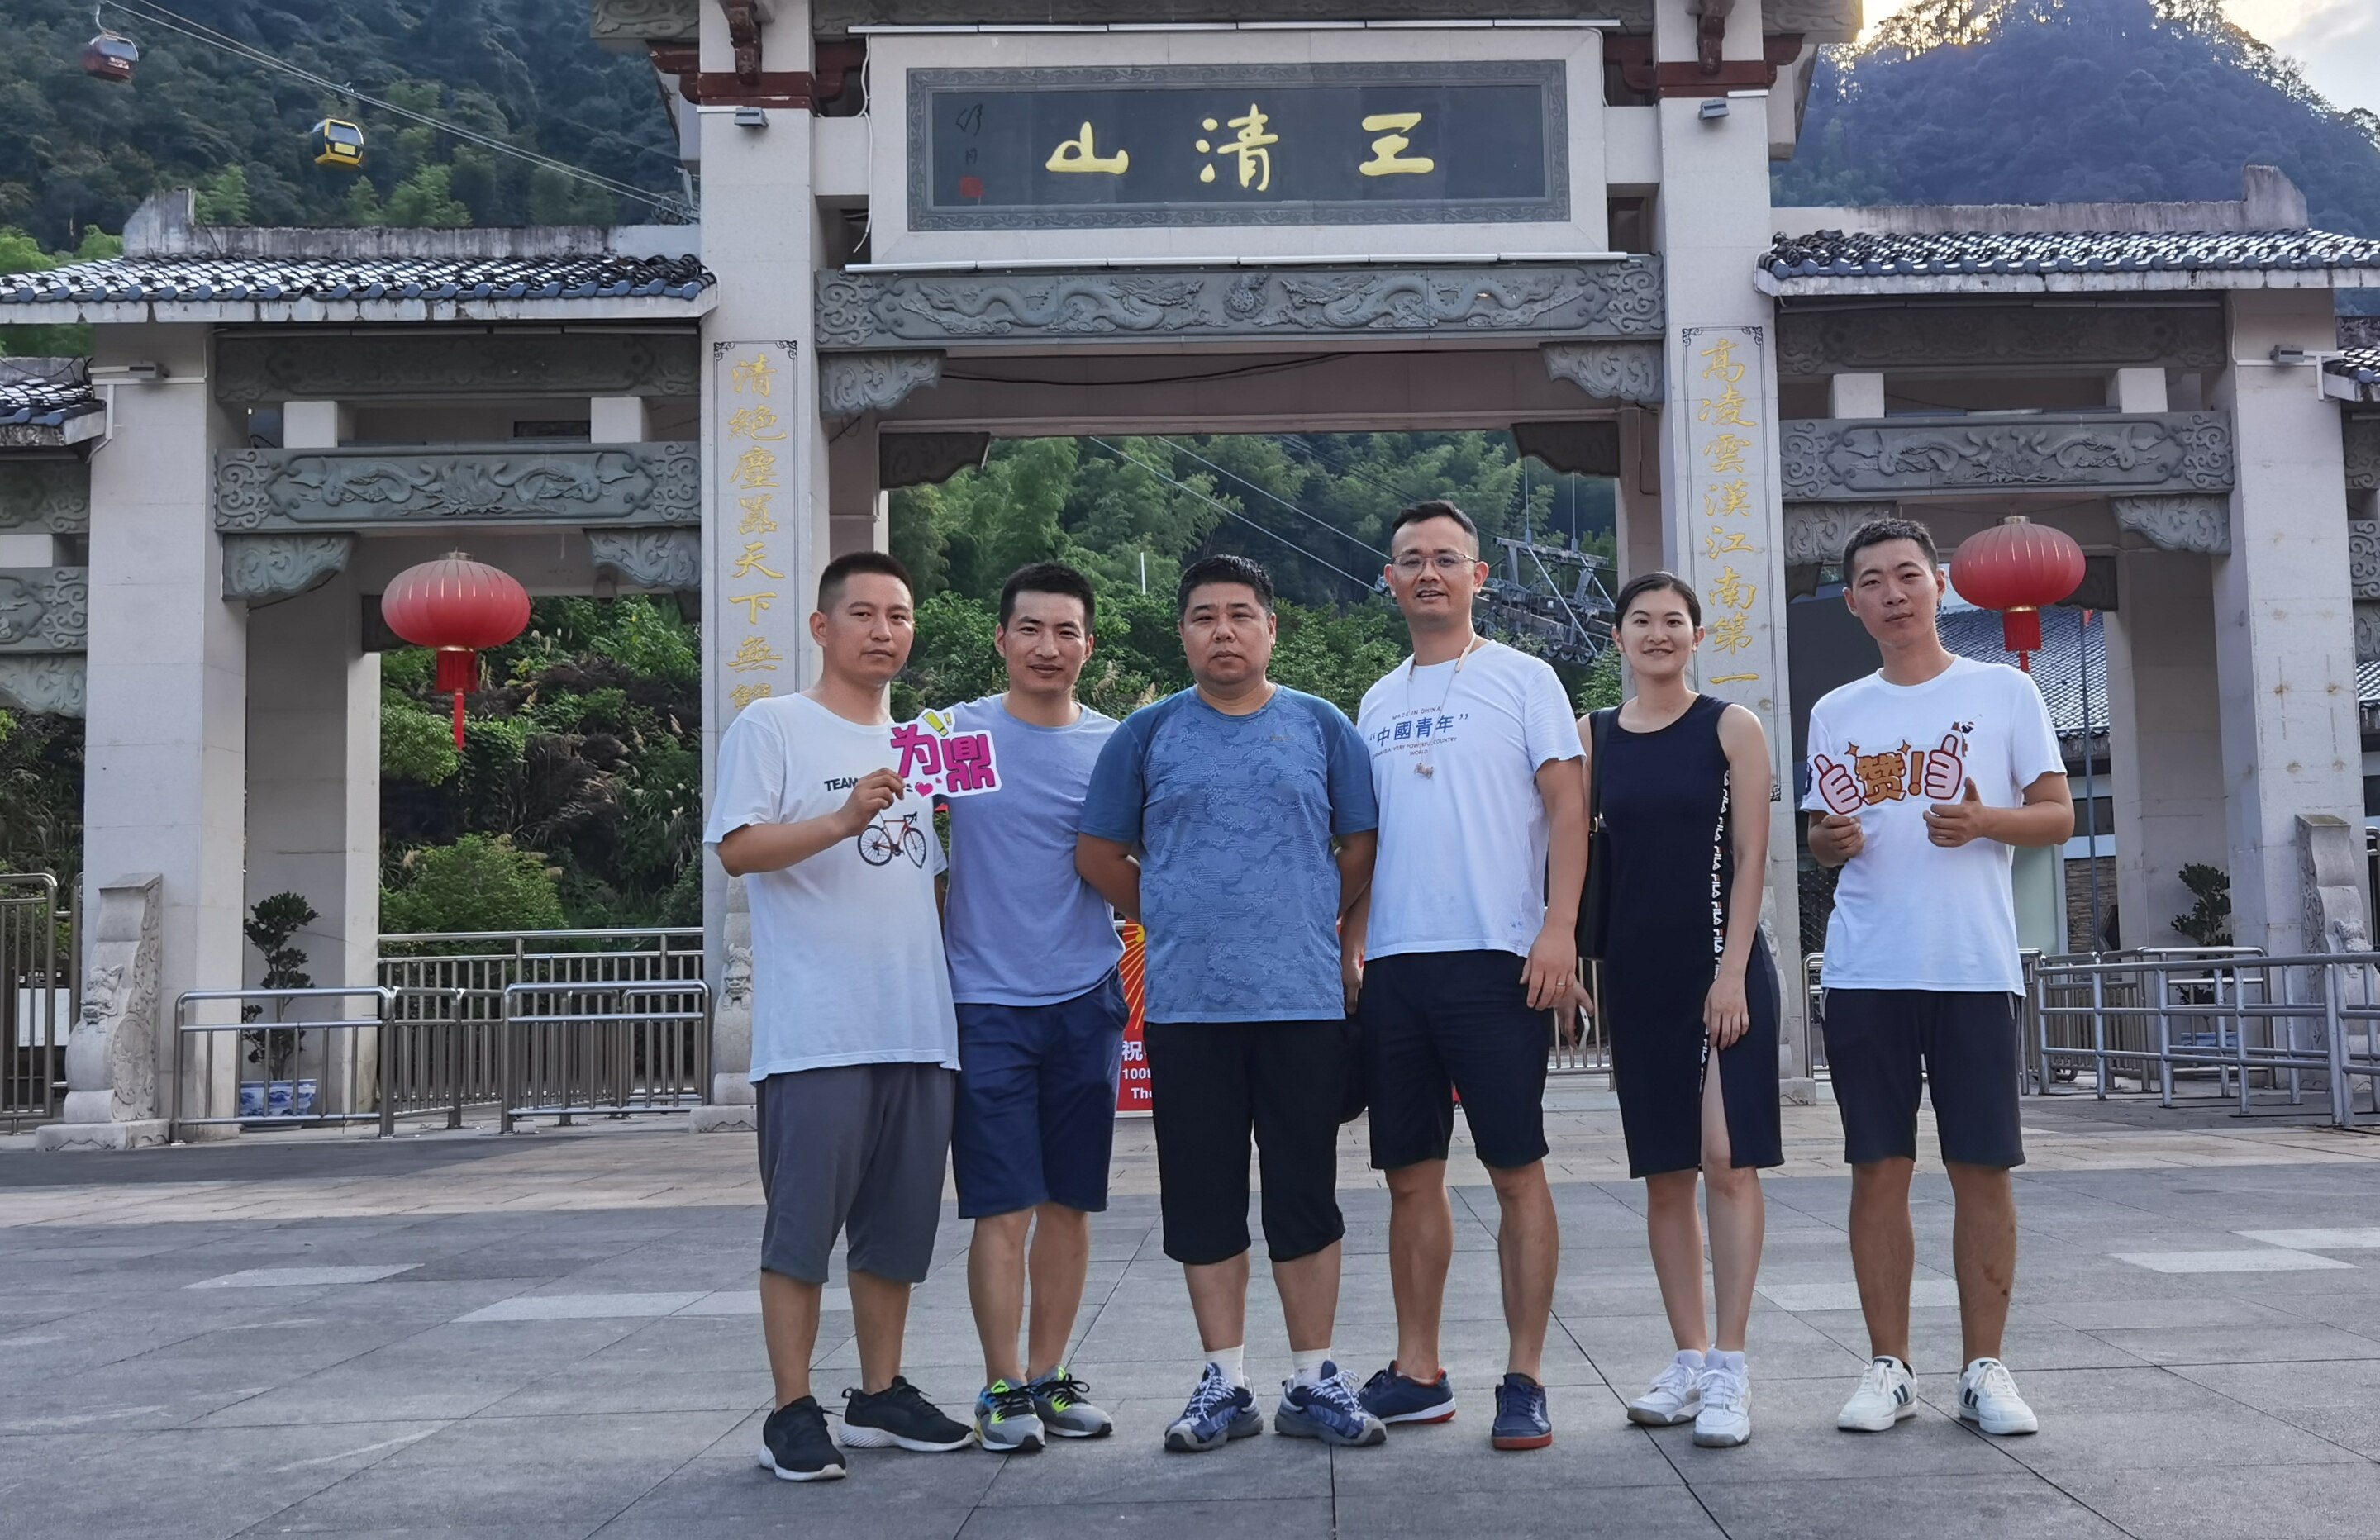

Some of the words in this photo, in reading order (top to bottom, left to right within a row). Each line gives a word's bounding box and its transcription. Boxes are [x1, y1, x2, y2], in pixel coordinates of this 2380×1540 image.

[1392, 711, 1409, 720] MADE
[1421, 706, 1441, 715] CHINA
[890, 724, 996, 793] 为鼎
[1721, 788, 1729, 814] FILA
[1714, 816, 1724, 842] FILA
[1712, 845, 1722, 871] FILA
[1711, 873, 1721, 899] FILA
[1711, 901, 1723, 925] FILA
[1713, 928, 1724, 953] FILA
[1122, 1041, 1146, 1061] 祝
